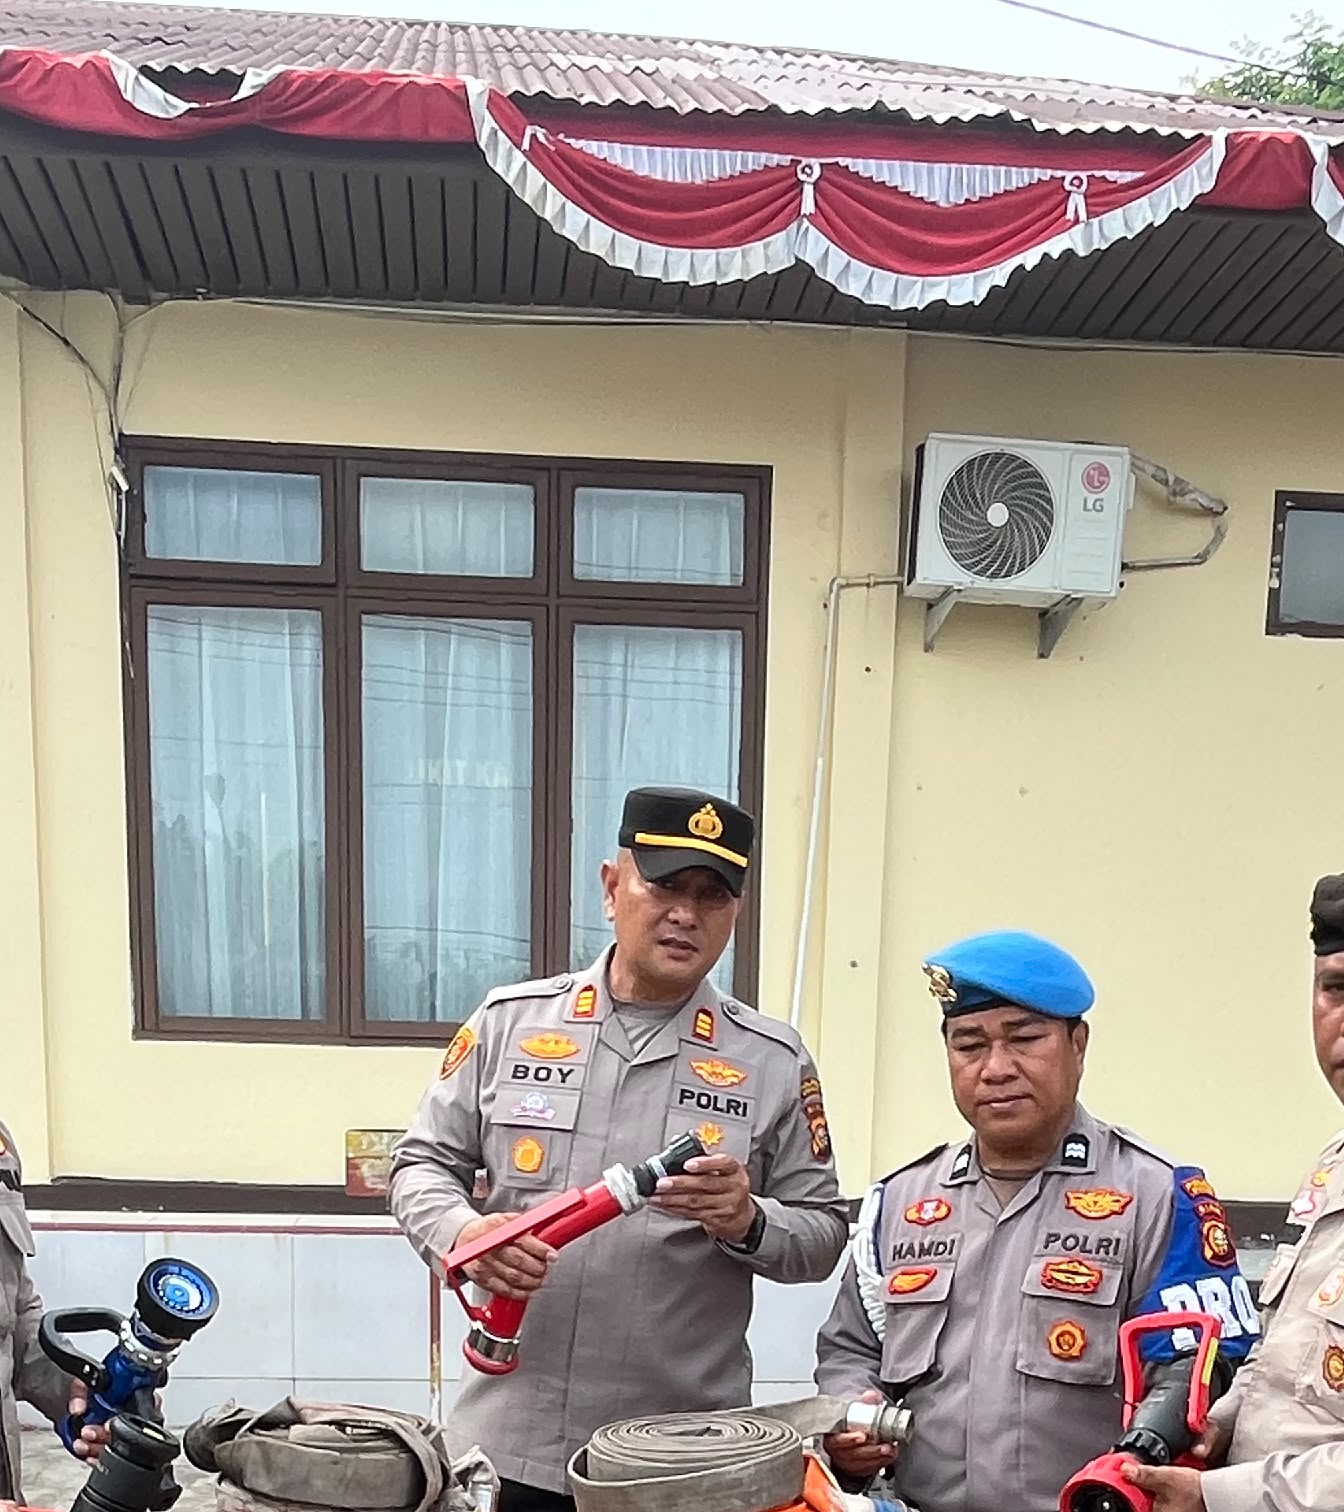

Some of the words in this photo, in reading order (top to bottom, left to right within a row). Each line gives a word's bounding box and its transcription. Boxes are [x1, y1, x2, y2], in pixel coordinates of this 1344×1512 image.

[1082, 496, 1105, 512] LG
[510, 1063, 576, 1084] BOY
[678, 1088, 749, 1118] POLRI
[891, 1238, 956, 1262] HAMDI
[1042, 1231, 1122, 1256] POLRI
